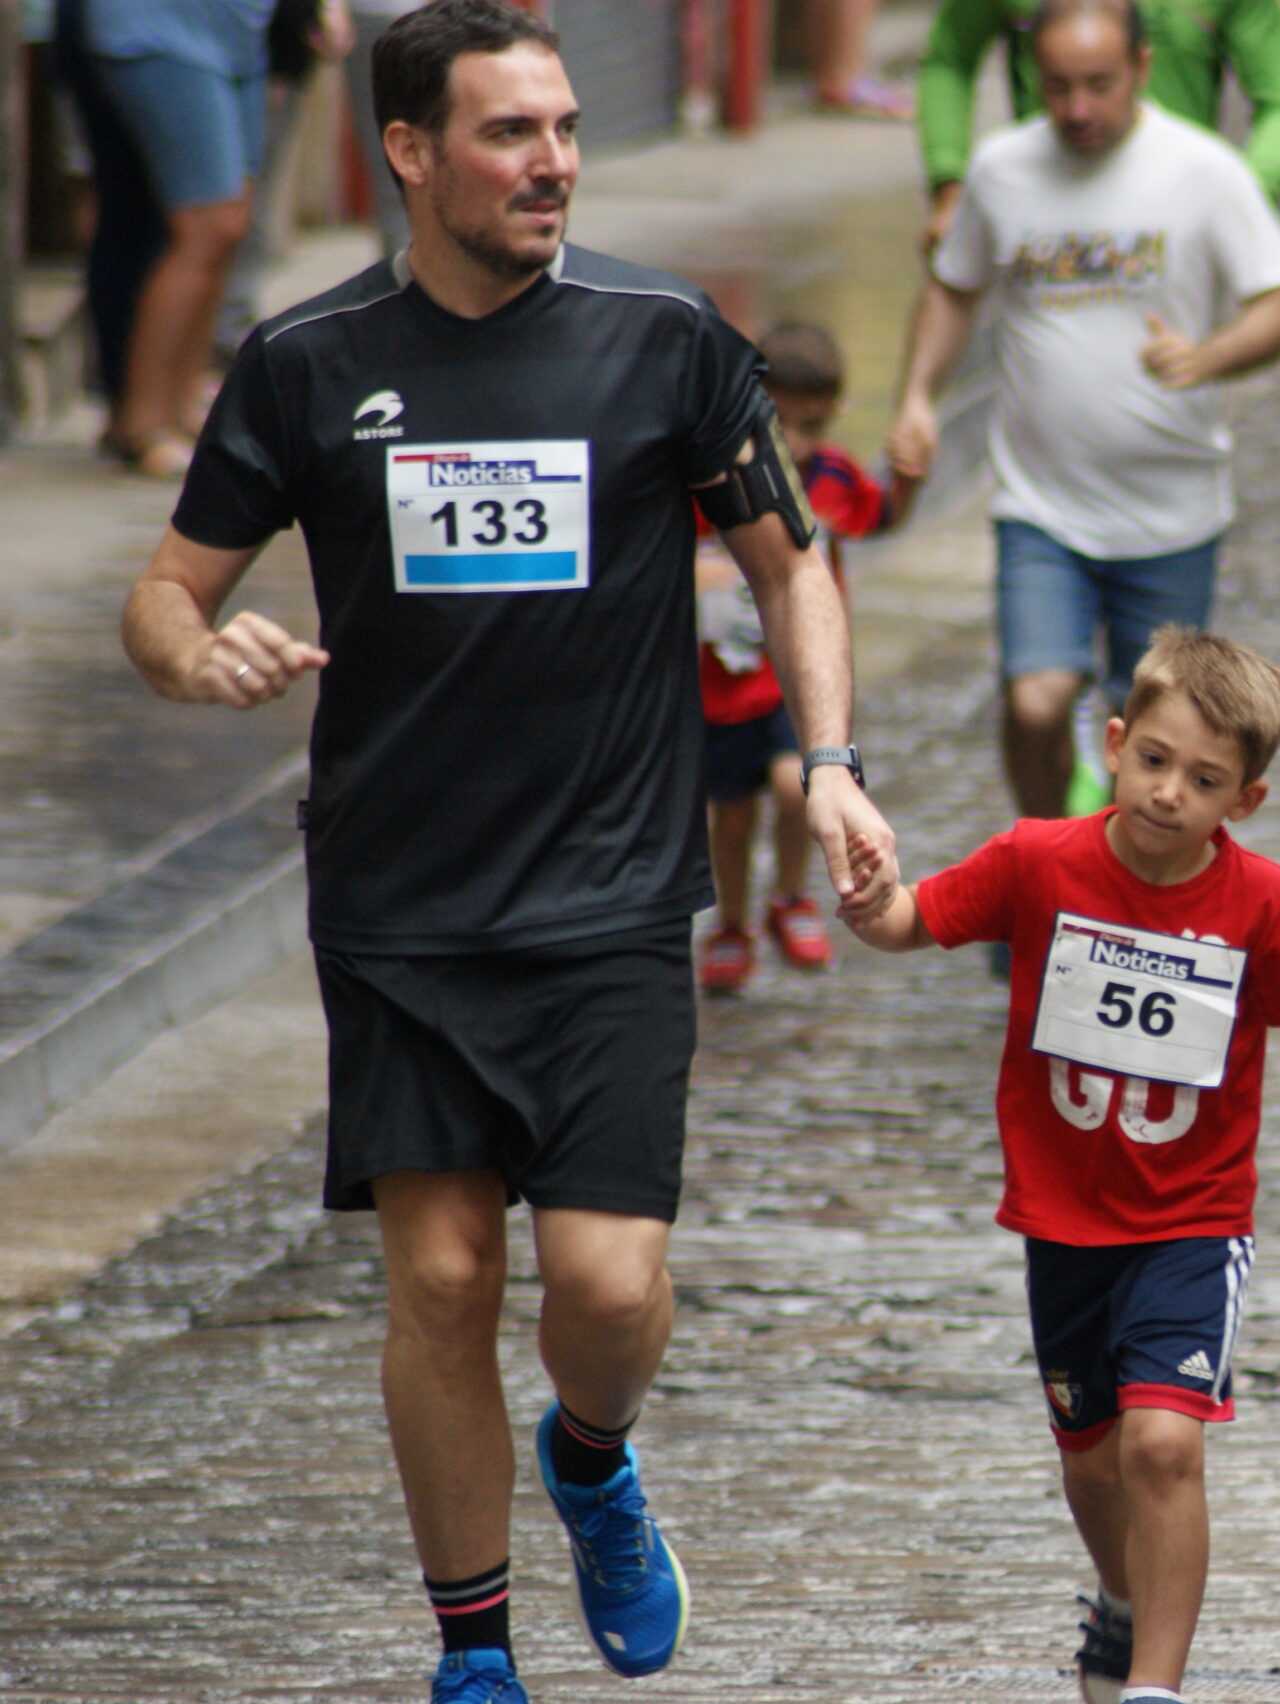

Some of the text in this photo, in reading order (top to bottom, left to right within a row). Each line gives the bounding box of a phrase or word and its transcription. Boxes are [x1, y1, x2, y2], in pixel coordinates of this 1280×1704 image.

[354, 426, 404, 440] ASTORE
[432, 462, 532, 486] Noticias
[431, 499, 549, 548] 133
[1093, 941, 1190, 980] Noticias
[1096, 981, 1177, 1038] 56
